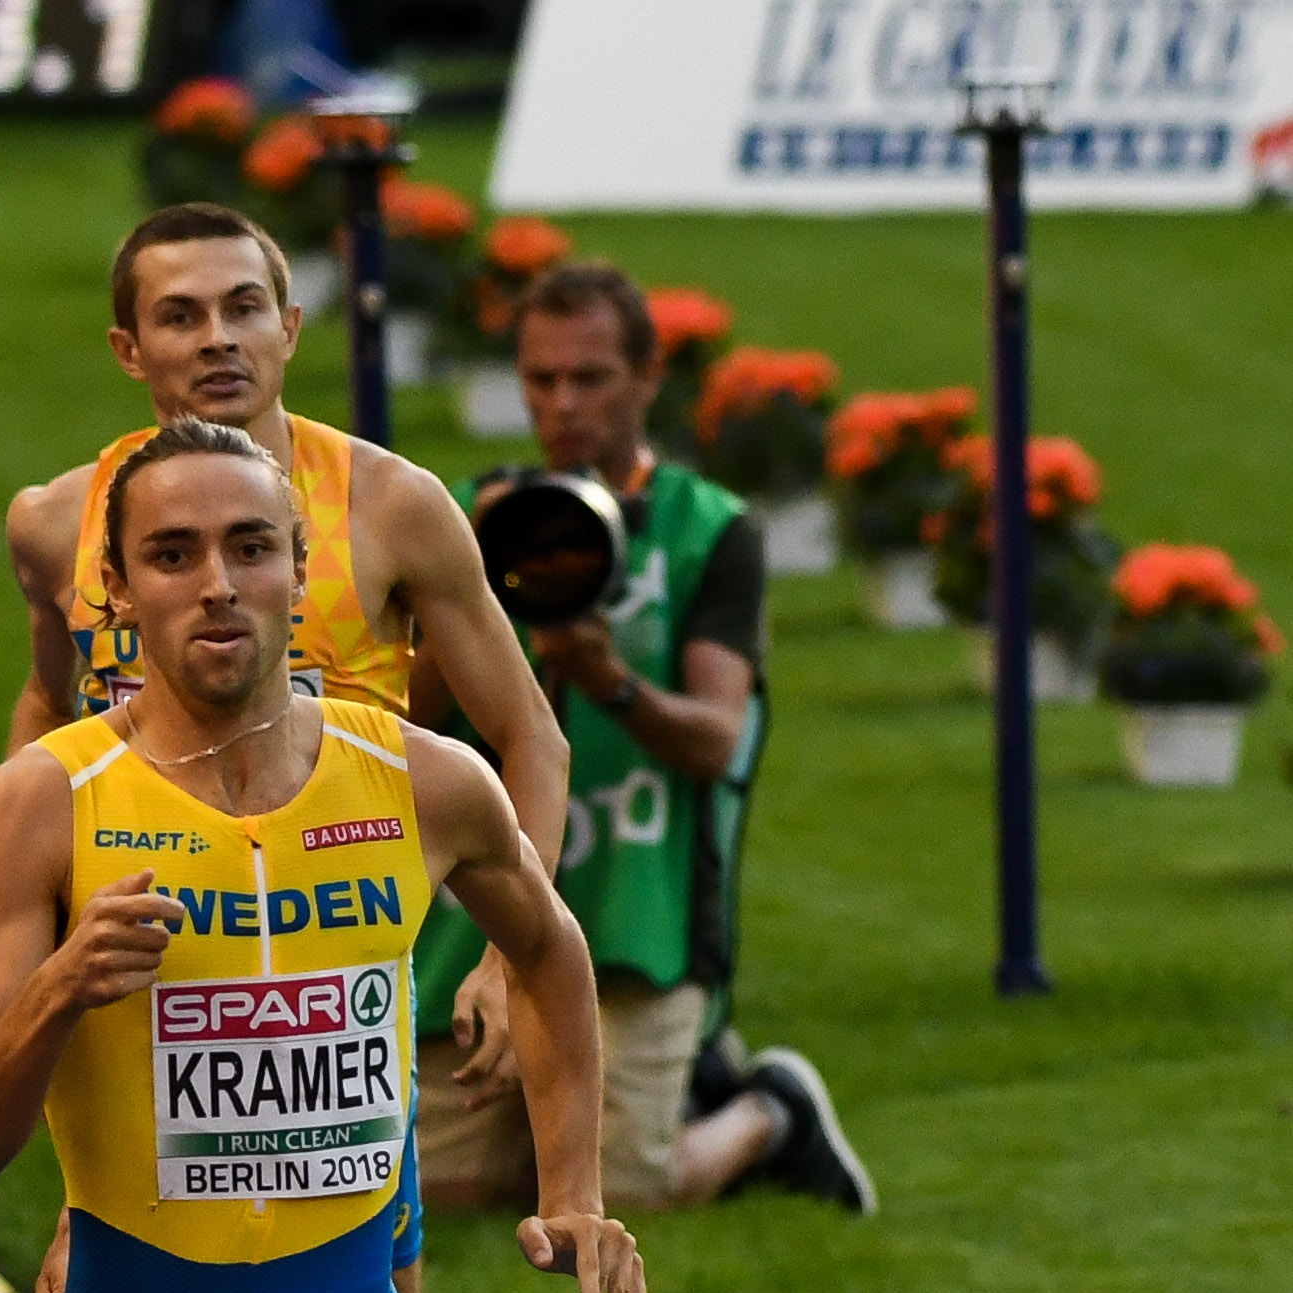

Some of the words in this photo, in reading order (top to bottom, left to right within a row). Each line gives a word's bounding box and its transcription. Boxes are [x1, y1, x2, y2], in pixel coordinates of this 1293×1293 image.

[94, 829, 186, 852] CRAFT
[303, 820, 403, 850] BAUHAUS
[138, 876, 403, 937] WEDEN
[162, 984, 342, 1034] SPAR
[166, 1036, 396, 1121] KRAMER
[229, 1133, 281, 1153] RUN
[185, 1160, 310, 1195] BERLIN
[320, 1150, 392, 1188] 2018
